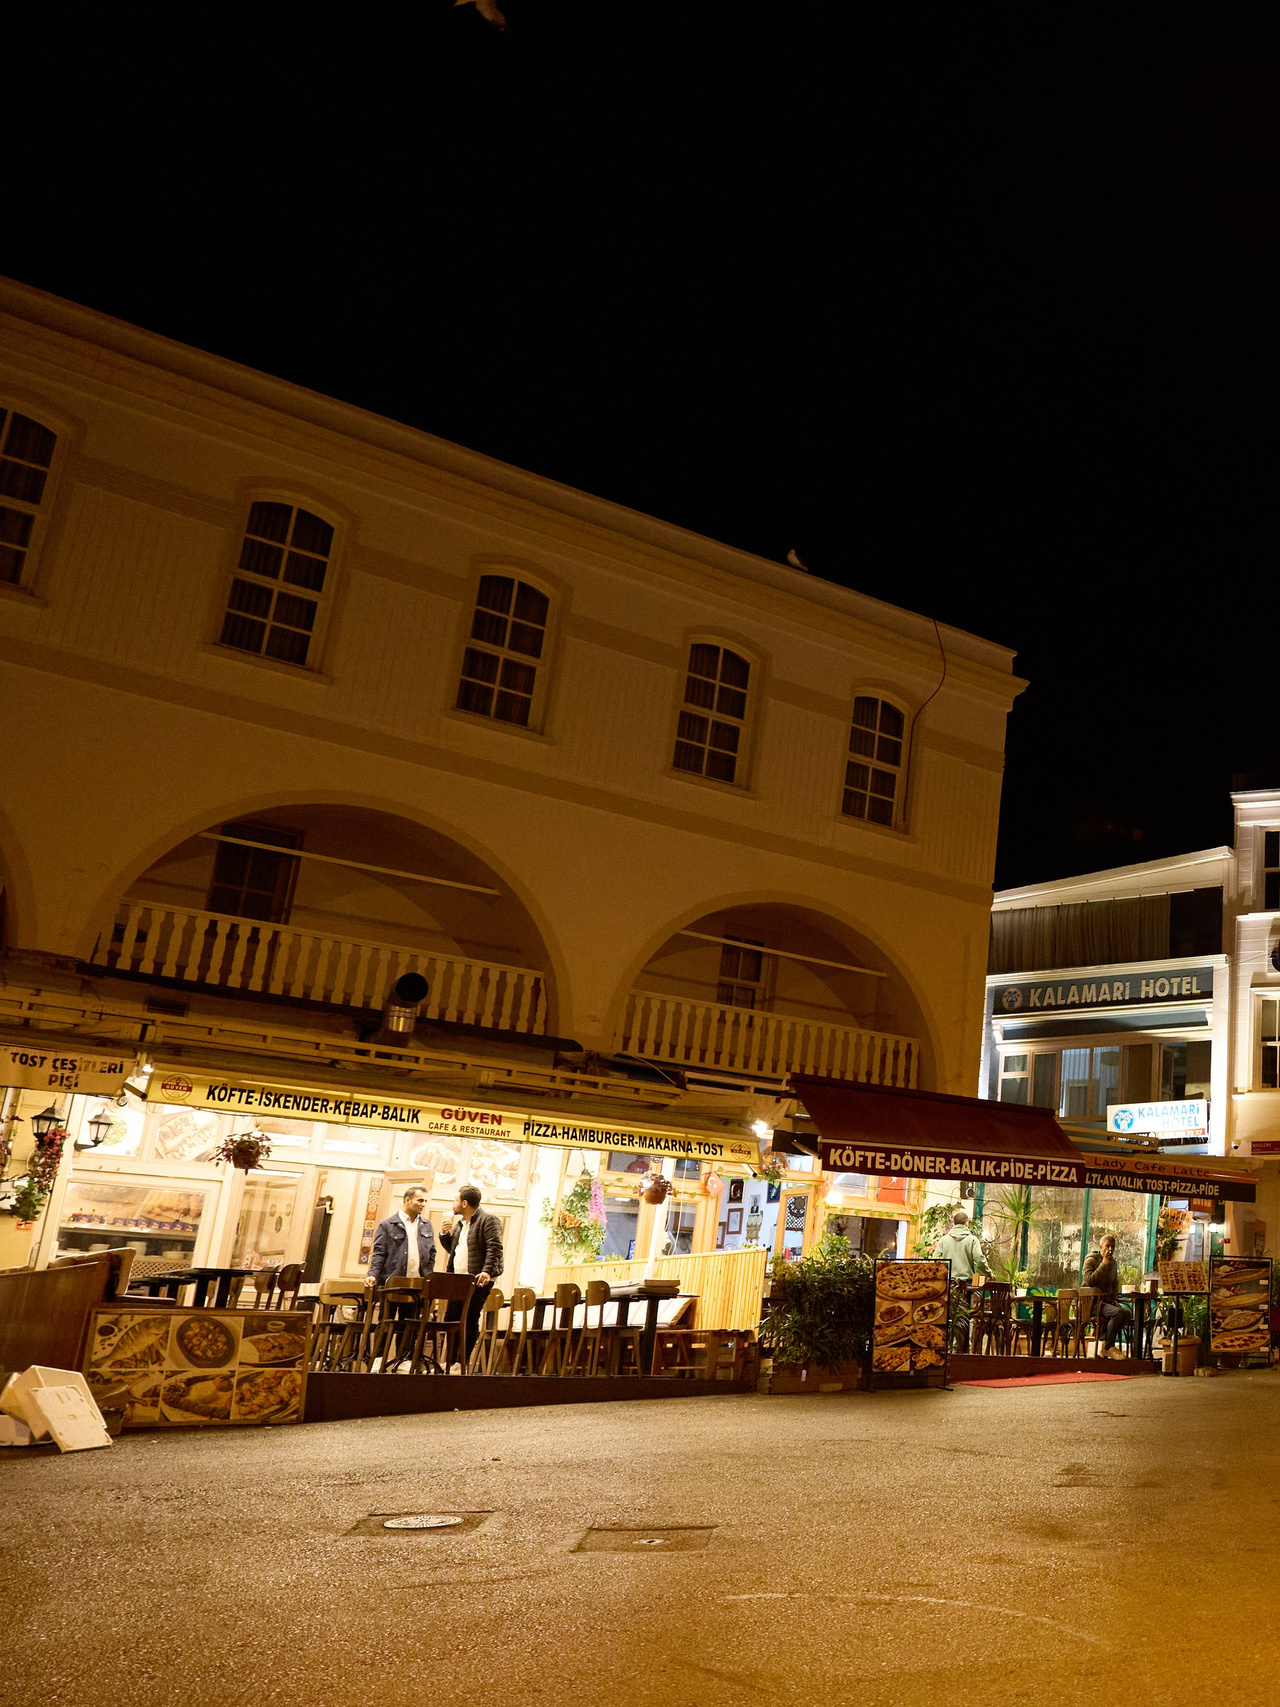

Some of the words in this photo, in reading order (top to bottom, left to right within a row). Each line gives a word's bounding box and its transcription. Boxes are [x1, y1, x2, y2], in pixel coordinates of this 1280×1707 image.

[1140, 976, 1201, 999] HOTEL
[10, 1052, 47, 1068] TOST
[48, 1073, 79, 1090] PİŞİ
[206, 1083, 421, 1124] KÖFTE-İSKENDER-KEBAP-BALIK
[441, 1108, 502, 1126] GÜVEN
[1162, 1115, 1199, 1129] HOTEL
[428, 1122, 449, 1132] CAFE
[459, 1125, 511, 1138] RESTAURANT
[523, 1119, 724, 1156] PİZZA-HAMBURGER-MAKARNA-TOST
[829, 1146, 1078, 1183] KÖFTE-DÖNER-BALIK-PİDE-PİZZA
[1094, 1157, 1126, 1171] Lady
[1134, 1161, 1166, 1173] Cafe
[1146, 1179, 1219, 1196] TOST-PİZZA-PİDE
